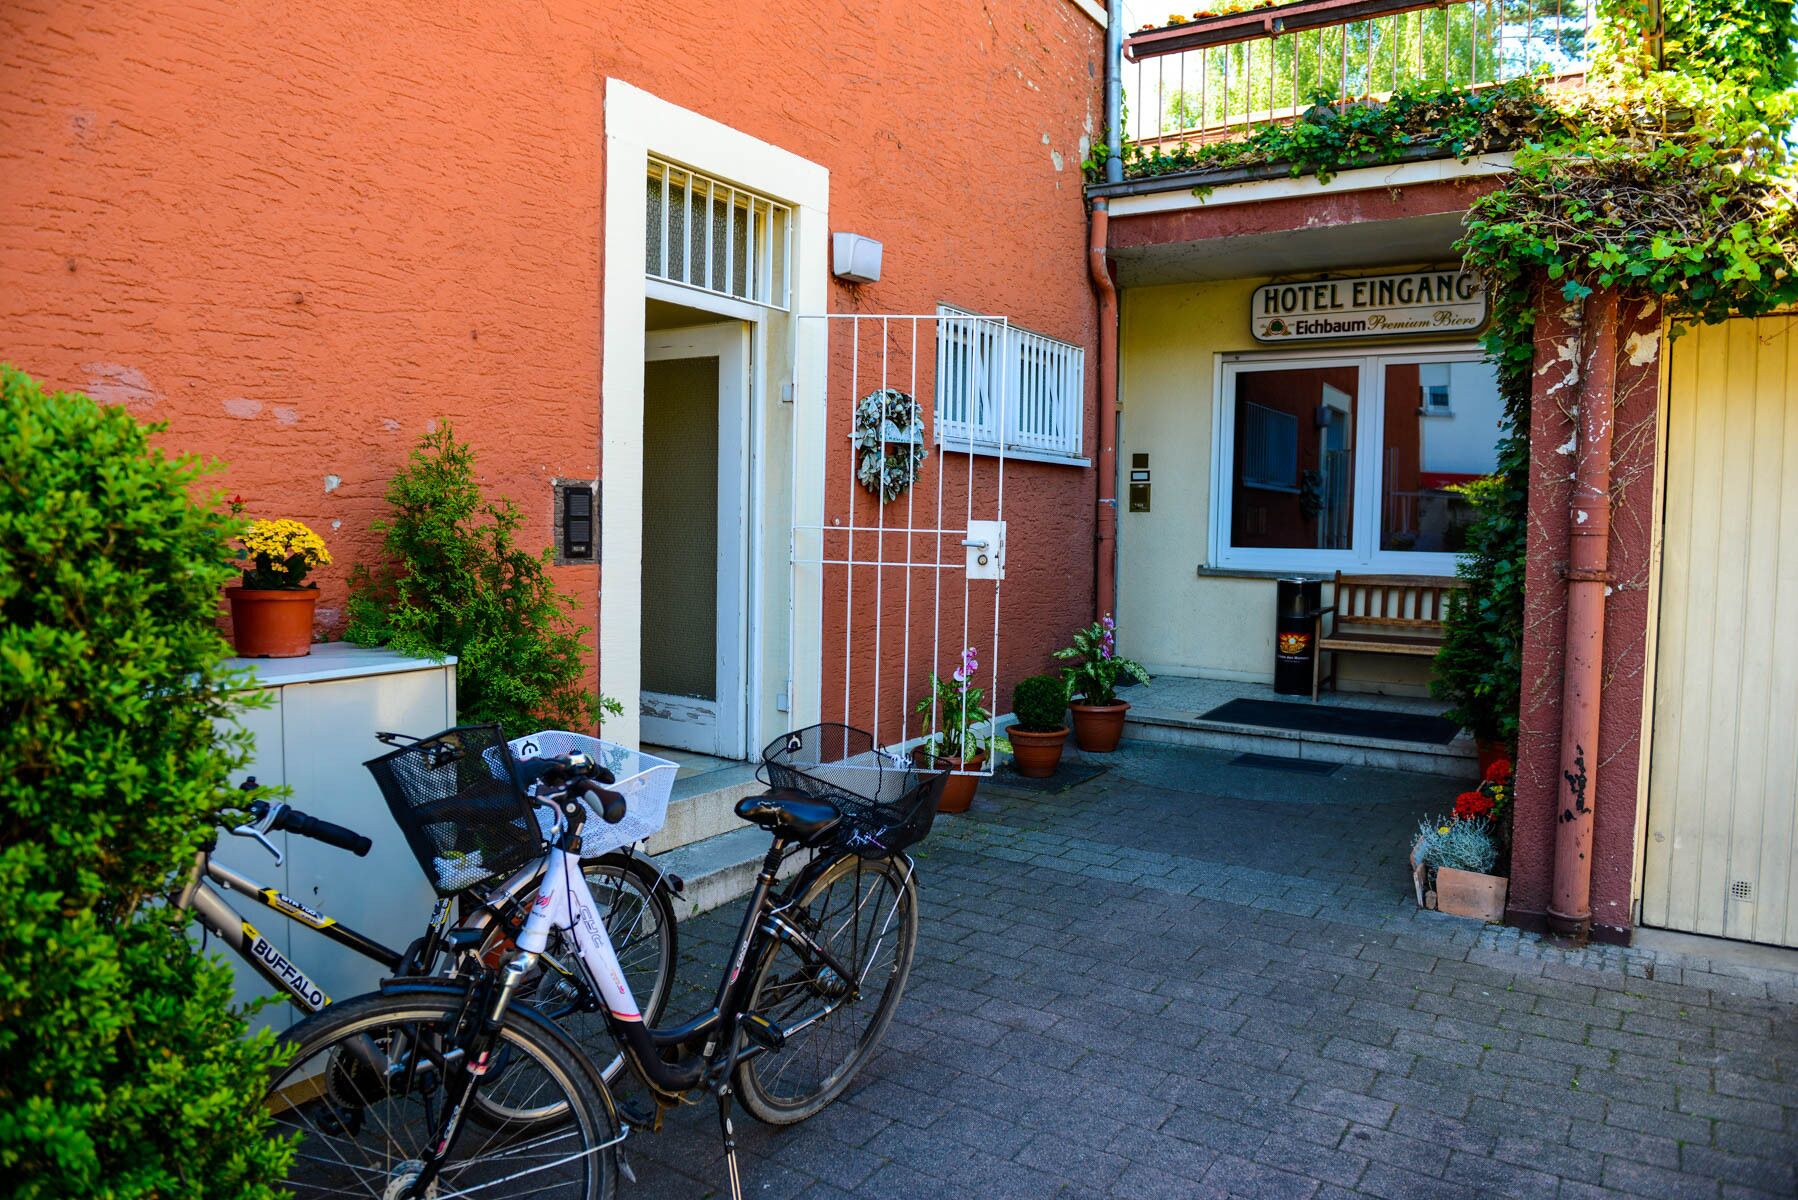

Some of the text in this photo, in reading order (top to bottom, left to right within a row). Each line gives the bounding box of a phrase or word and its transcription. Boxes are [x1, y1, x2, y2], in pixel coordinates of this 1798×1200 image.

[1264, 273, 1474, 314] HOTEL EINGANG
[1296, 311, 1476, 335] Eichbaum Premium Biere
[253, 938, 322, 1006] BUFFALO
